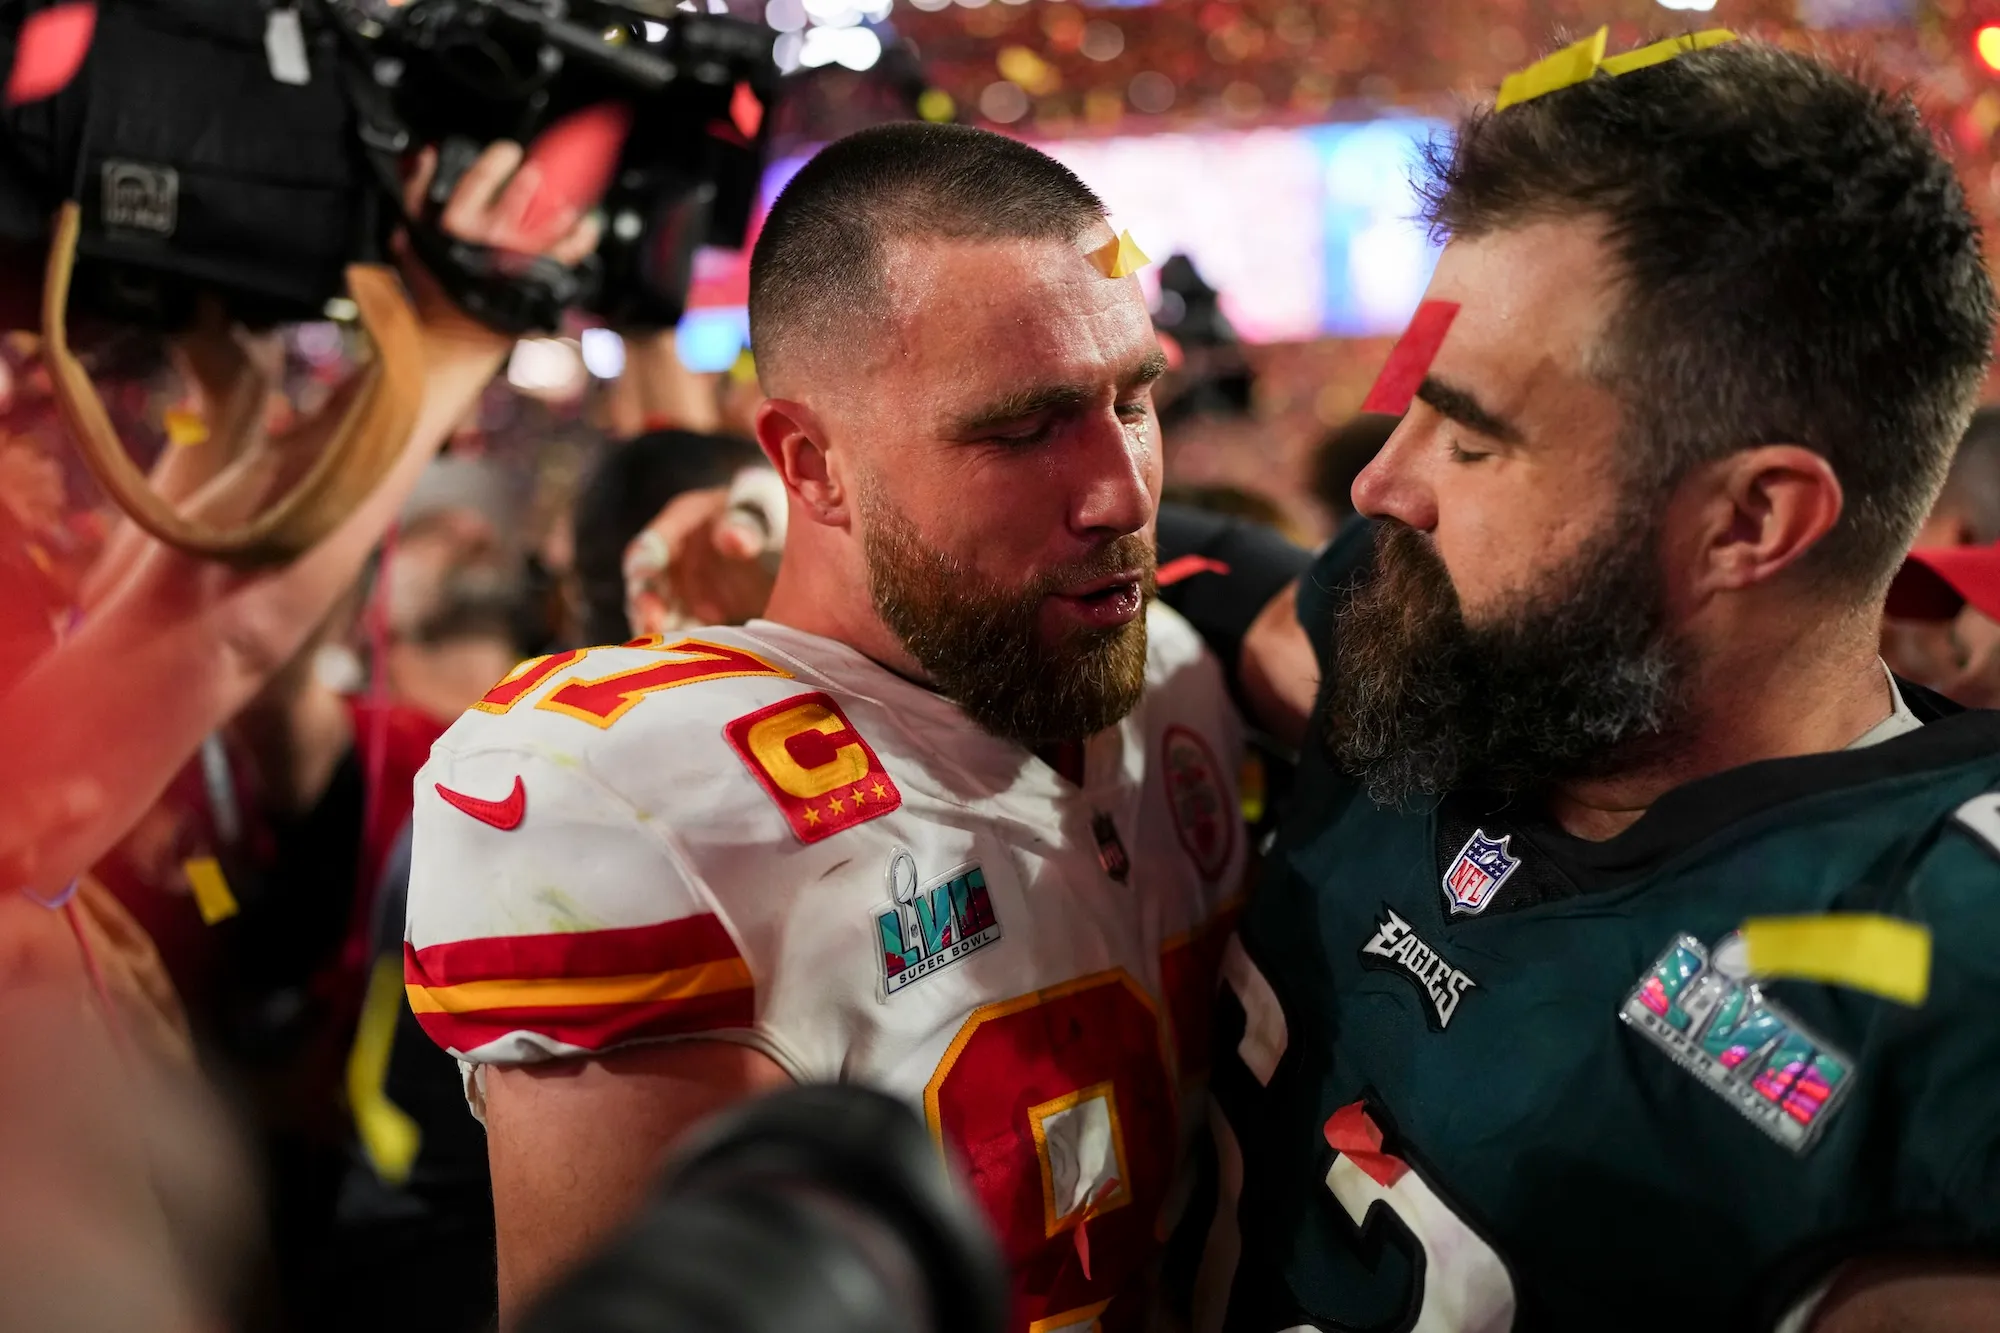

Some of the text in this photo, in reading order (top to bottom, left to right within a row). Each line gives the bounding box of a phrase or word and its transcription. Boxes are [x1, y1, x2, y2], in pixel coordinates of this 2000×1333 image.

[748, 703, 870, 799] C
[879, 867, 998, 978] LVII
[1449, 858, 1489, 903] NFL
[899, 933, 990, 984] SUPER BOWL
[1362, 908, 1476, 1029] EAGLES
